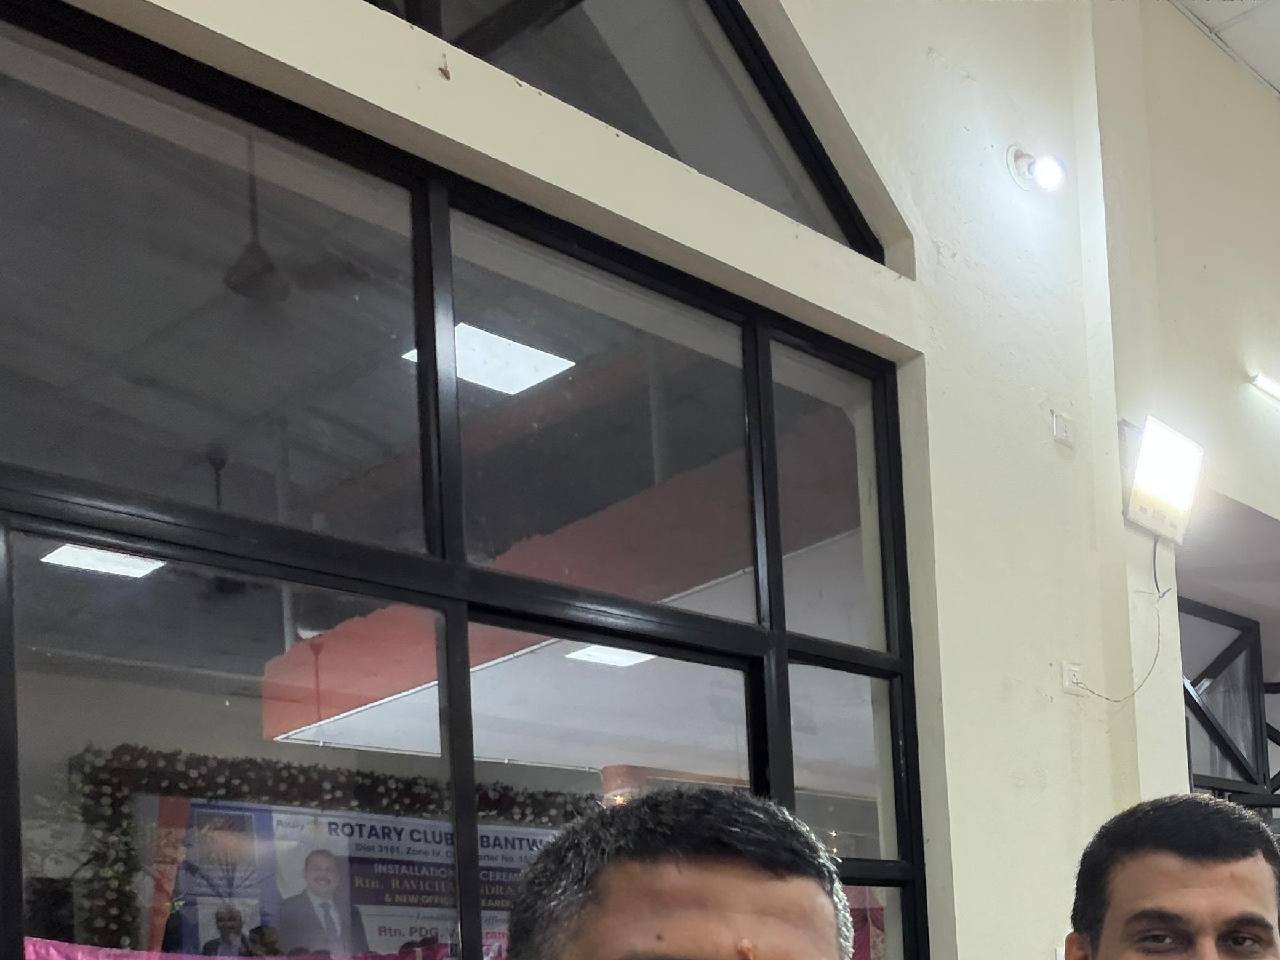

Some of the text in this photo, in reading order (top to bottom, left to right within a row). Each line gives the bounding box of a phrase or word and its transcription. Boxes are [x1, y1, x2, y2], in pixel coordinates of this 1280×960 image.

[328, 822, 544, 851] ROTARY CLUB BANTW
